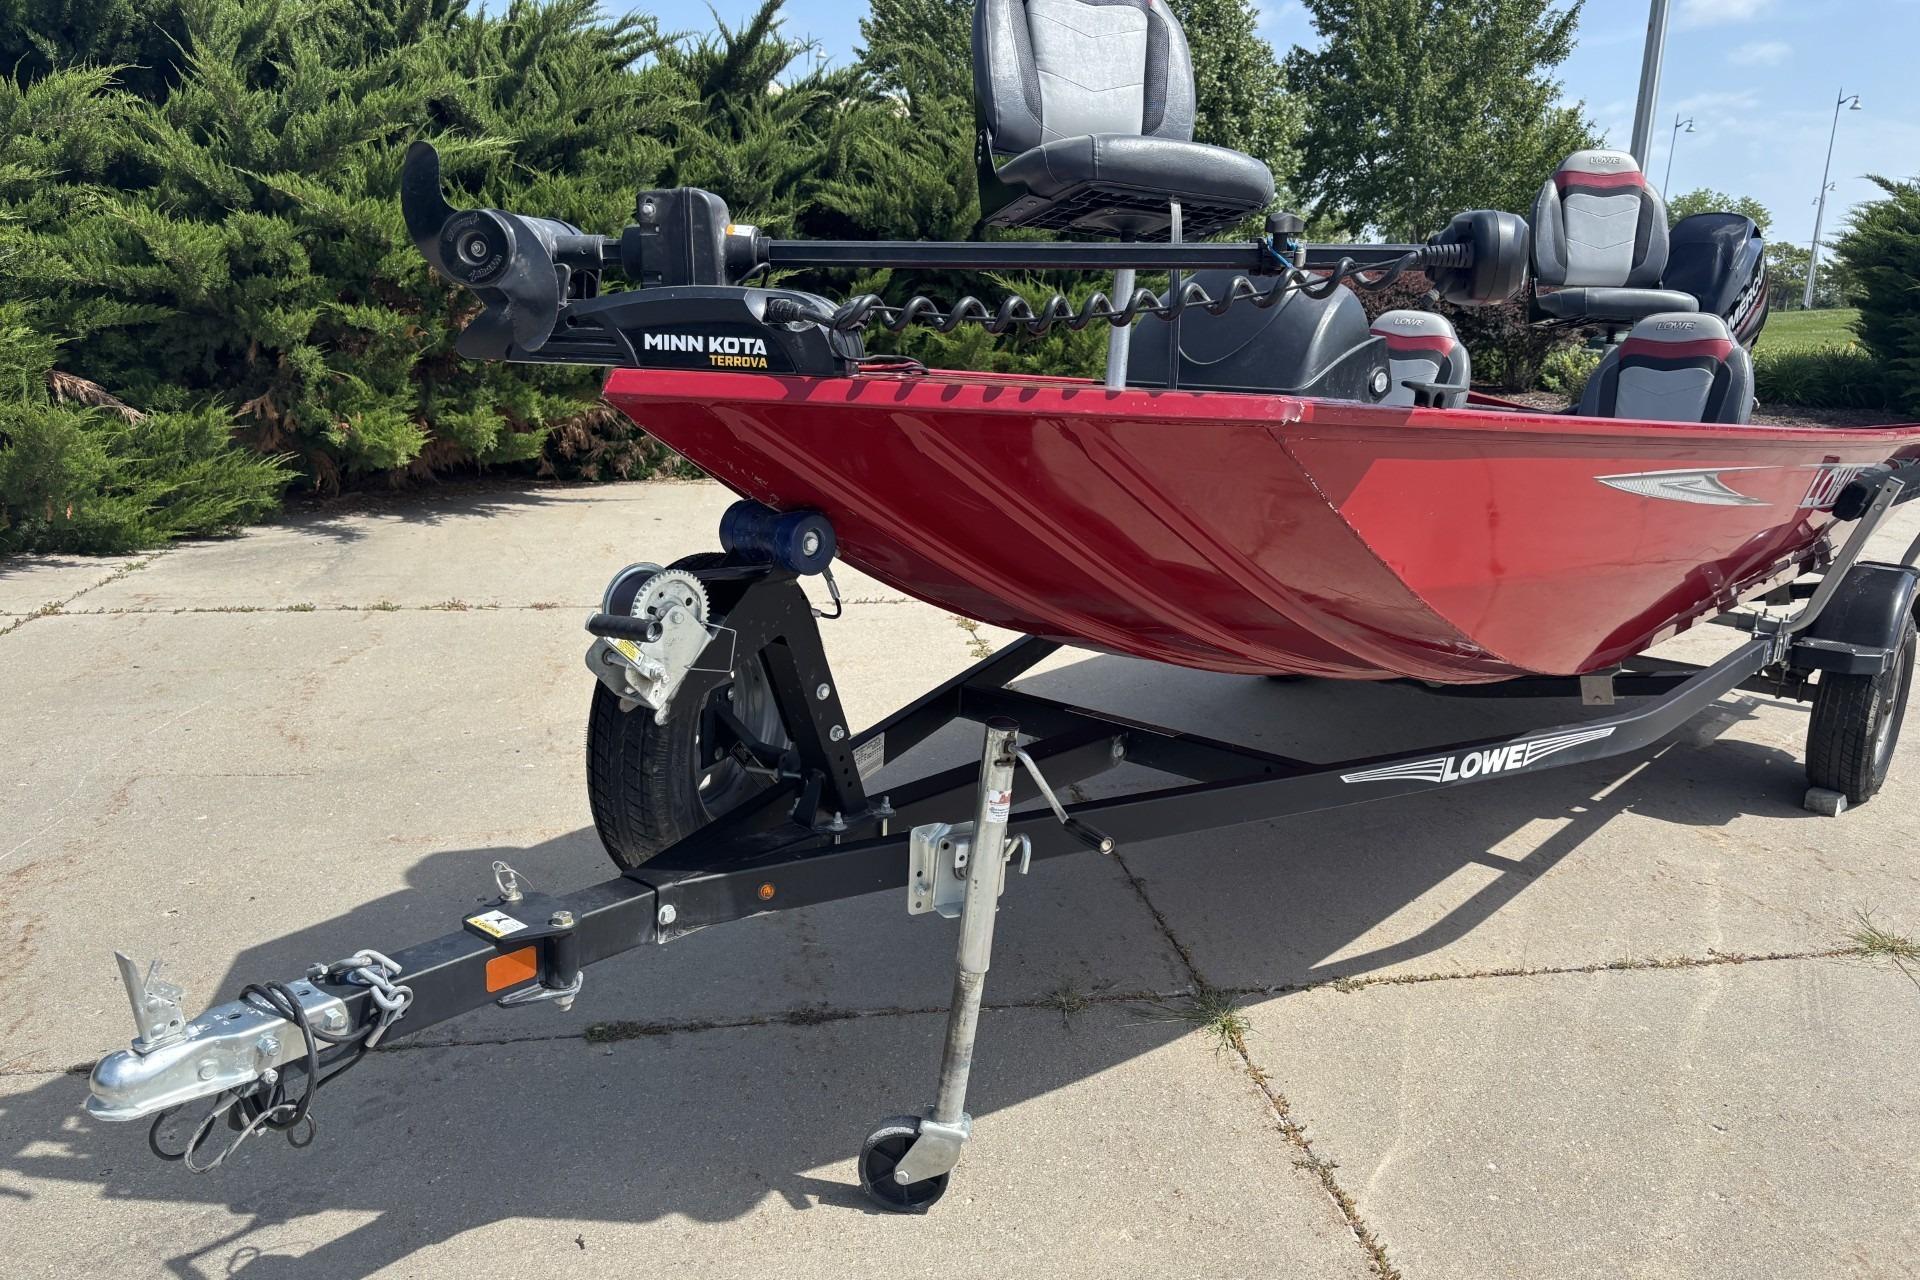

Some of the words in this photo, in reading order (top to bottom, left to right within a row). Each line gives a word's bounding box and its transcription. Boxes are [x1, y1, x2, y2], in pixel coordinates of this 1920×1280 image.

[1590, 156, 1621, 164] LOWE
[1728, 256, 1766, 330] MERCU
[1392, 318, 1425, 326] LOWE
[1656, 320, 1696, 331] LOWE
[644, 333, 703, 352] MINN
[708, 336, 767, 355] KOTA
[709, 354, 767, 368] TERROVA
[1442, 743, 1527, 782] LOWE
